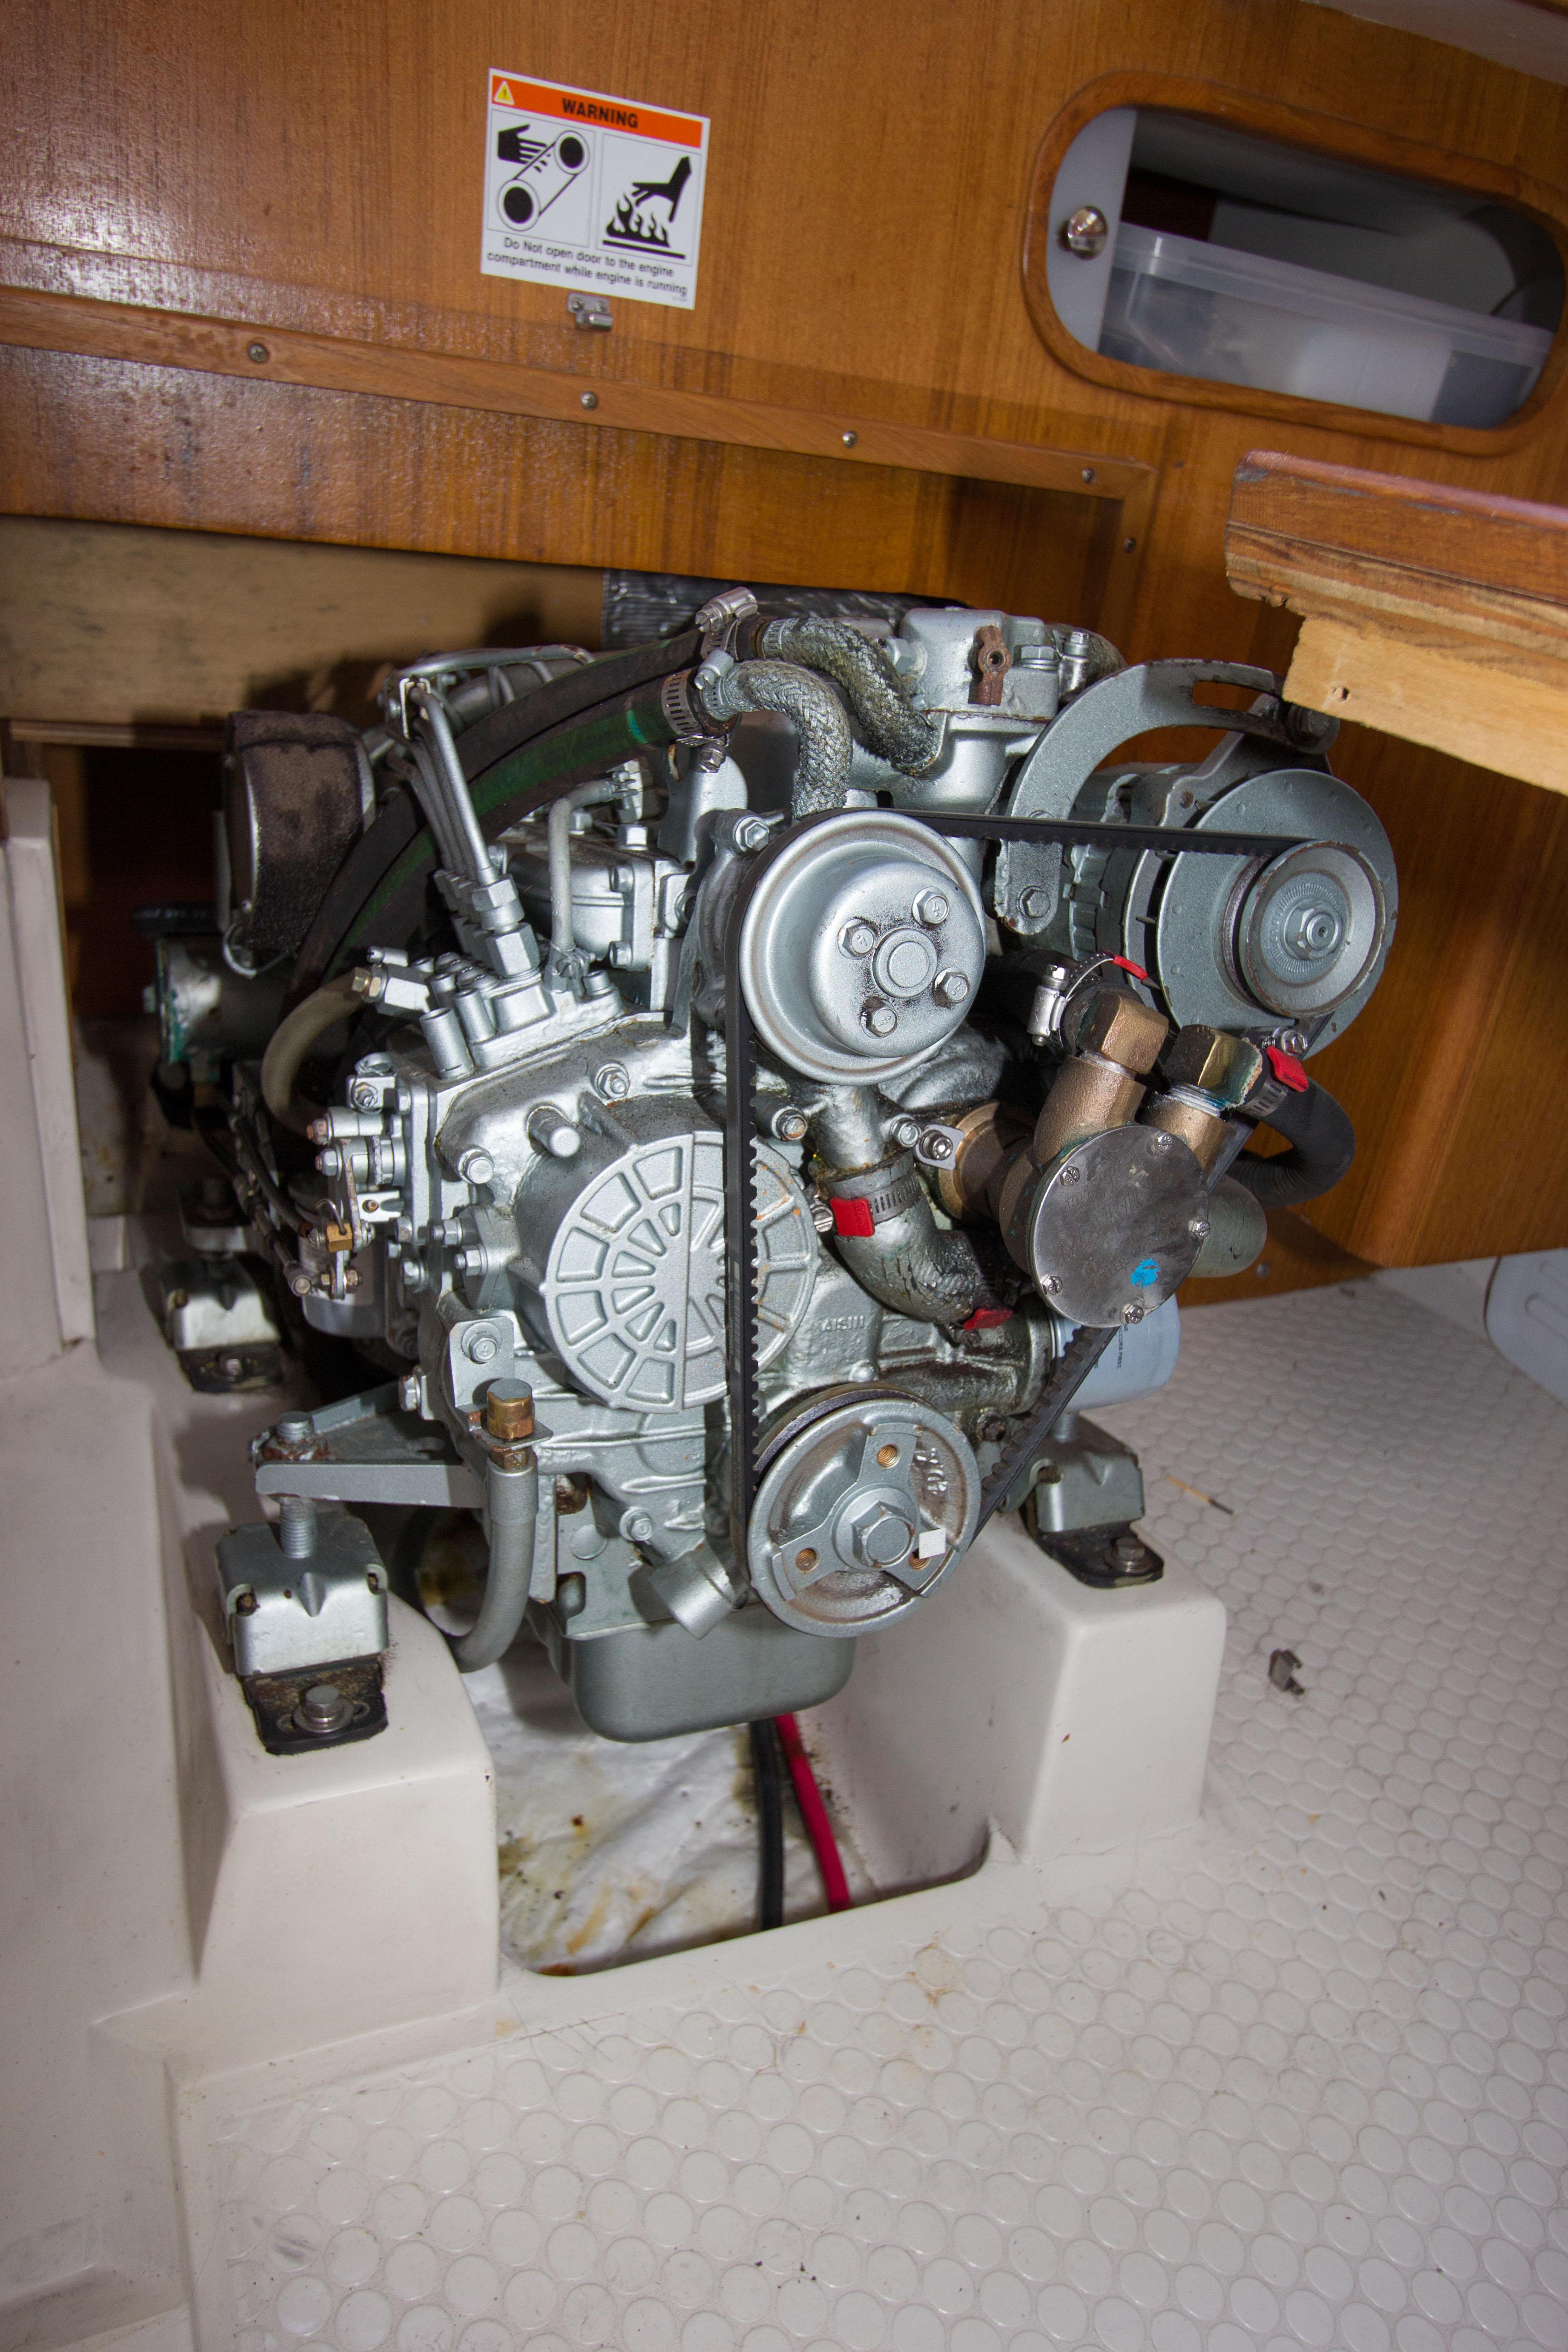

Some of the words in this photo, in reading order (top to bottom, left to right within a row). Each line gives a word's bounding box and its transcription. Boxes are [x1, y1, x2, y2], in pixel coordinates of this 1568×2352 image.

[562, 97, 638, 128] WARNING
[487, 252, 561, 272] compartment
[564, 265, 592, 278] while
[595, 271, 632, 285] engine
[635, 276, 644, 287] is
[647, 279, 687, 297] running
[504, 237, 519, 249] Do
[524, 240, 542, 254] Not
[545, 247, 573, 259] open
[576, 251, 602, 264] door
[605, 256, 616, 267] to
[619, 258, 636, 270] the
[638, 263, 674, 277] engine
[1054, 1176, 1166, 1269] MARIN
